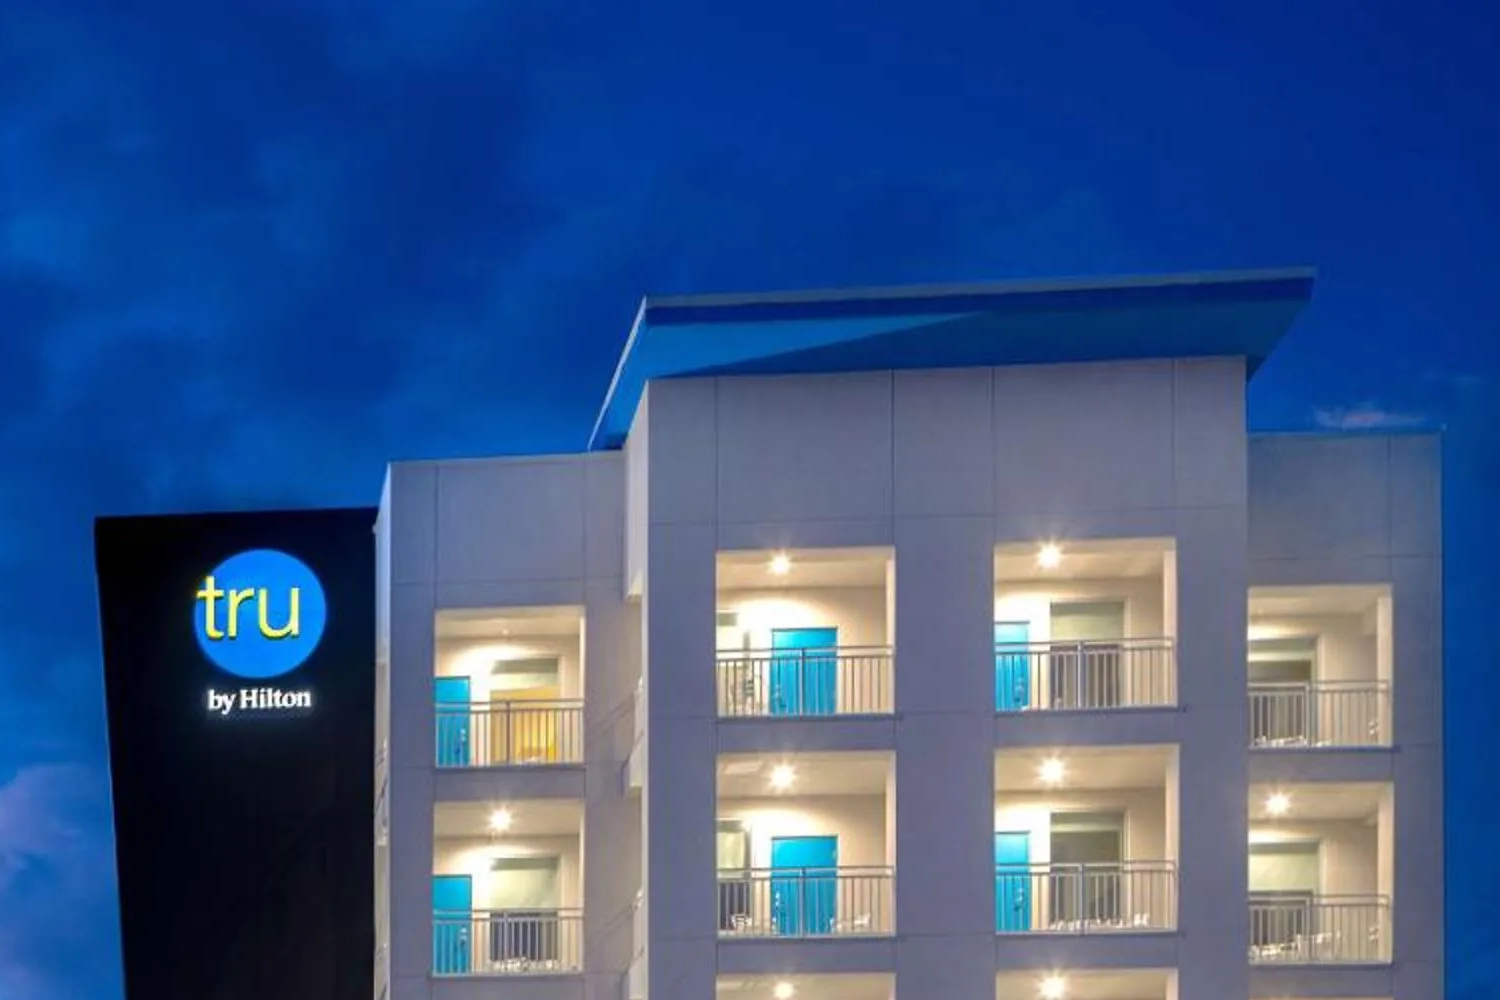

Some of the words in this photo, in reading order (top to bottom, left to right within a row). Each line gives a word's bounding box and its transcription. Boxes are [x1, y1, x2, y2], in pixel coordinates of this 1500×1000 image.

[196, 575, 301, 639] tru
[207, 690, 235, 715] by
[239, 688, 312, 709] Hilton
